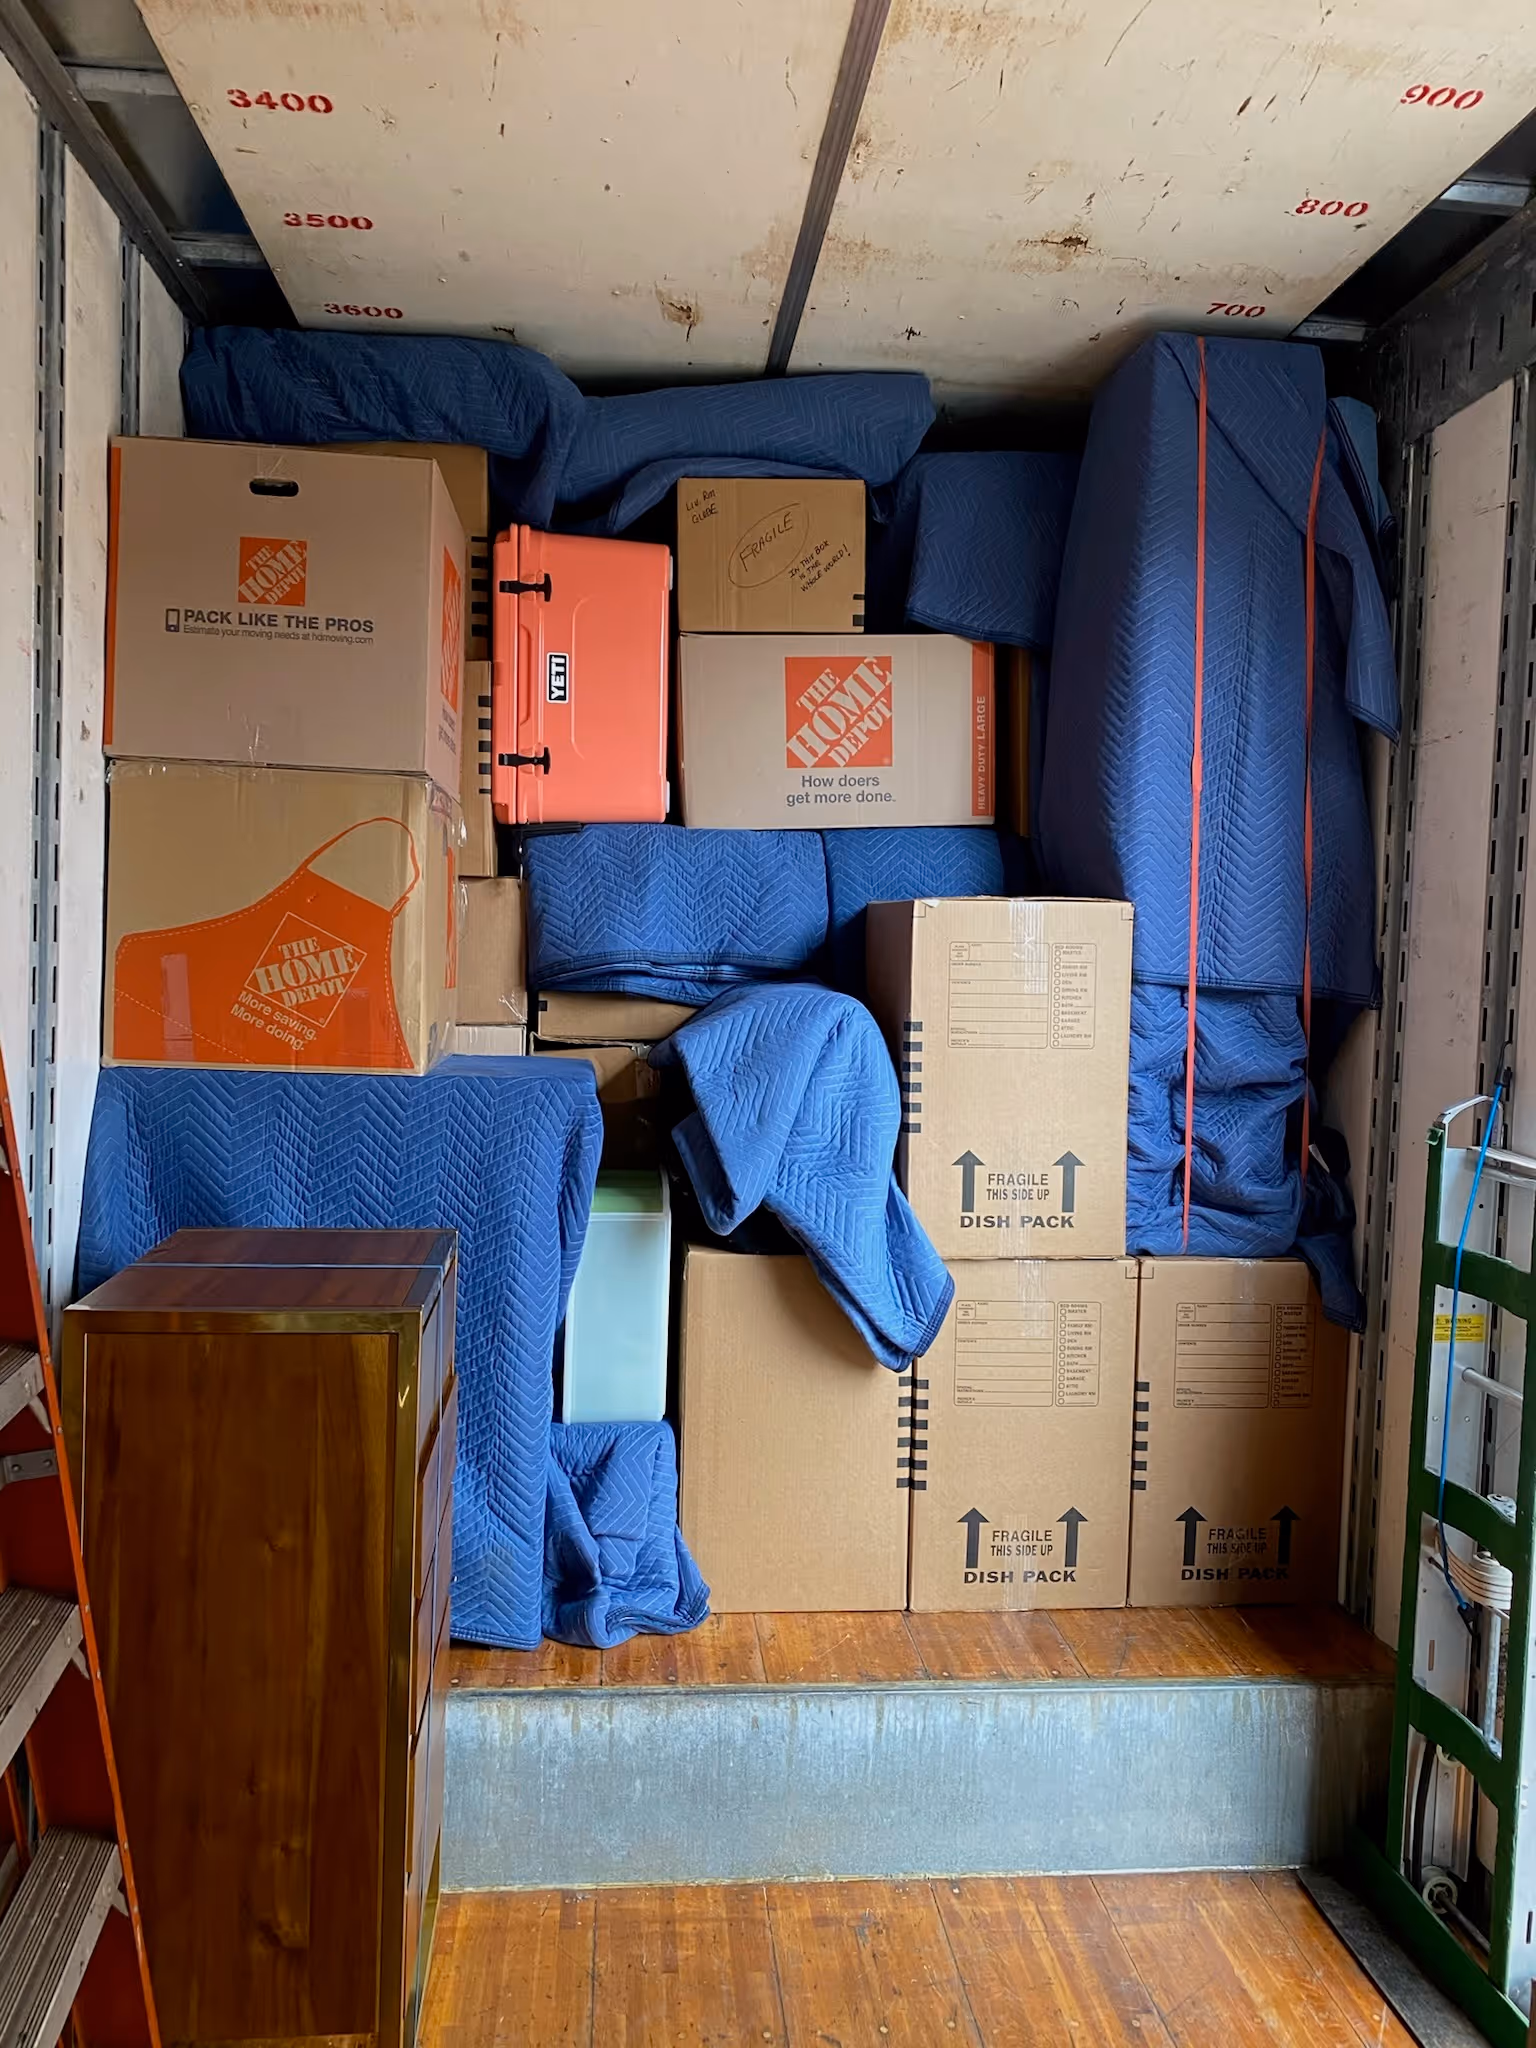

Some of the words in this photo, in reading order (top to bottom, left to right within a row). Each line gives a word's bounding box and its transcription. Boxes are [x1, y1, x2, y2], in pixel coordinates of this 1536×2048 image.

[227, 88, 333, 114] 3400
[1399, 84, 1485, 110] 900
[1295, 198, 1368, 218] 800
[283, 211, 373, 231] 3500
[324, 301, 403, 319] 3600
[1206, 301, 1266, 319] 700
[739, 512, 793, 573] FRAGILE
[815, 540, 830, 555] BOX
[246, 544, 274, 570] THE
[238, 540, 307, 604] HOME
[264, 564, 306, 605] DEPOT
[184, 609, 232, 625] PACK
[238, 612, 278, 627] LIKE
[285, 615, 319, 630] THE
[325, 618, 374, 633] PROS
[184, 625, 220, 635] Estimate
[221, 628, 240, 638] your
[242, 629, 273, 640] moving
[275, 630, 300, 641] needs
[302, 632, 310, 640] at
[312, 632, 374, 645] hdmoving.com
[550, 655, 565, 700] YETI
[796, 668, 840, 714] THE
[786, 656, 892, 768] HOME
[977, 696, 986, 738] LARGE
[828, 697, 892, 767] DEPOT
[977, 741, 986, 772] DUTY
[801, 775, 833, 788] How
[838, 774, 880, 788] doers
[977, 775, 986, 809] HEAVY
[786, 792, 811, 806] get
[814, 792, 851, 804] more
[278, 937, 319, 959] THE
[254, 946, 358, 996] HOME
[281, 977, 346, 1008] DEPOT
[230, 1005, 264, 1029] More
[238, 992, 271, 1015] More
[272, 1010, 317, 1041] saving.
[988, 1173, 1049, 1186] FRAGILE
[986, 1188, 1008, 1201] THIS
[1011, 1188, 1034, 1201] SIDE
[1037, 1188, 1050, 1201] UP
[960, 1215, 1010, 1228] DISH
[1021, 1215, 1074, 1228] PACK
[992, 1530, 1053, 1542] FRAGILE
[1209, 1528, 1267, 1540] FRAGILE
[991, 1544, 1012, 1556] THIS
[1015, 1544, 1037, 1556] SIDE
[1040, 1544, 1053, 1556] UP
[1207, 1543, 1227, 1554] THIS
[1230, 1543, 1252, 1554] SIDE
[1255, 1542, 1268, 1554] UP
[964, 1571, 1014, 1583] DISH
[1023, 1570, 1077, 1583] PACK
[1181, 1568, 1229, 1580] DISH
[1238, 1567, 1289, 1579] PACK
